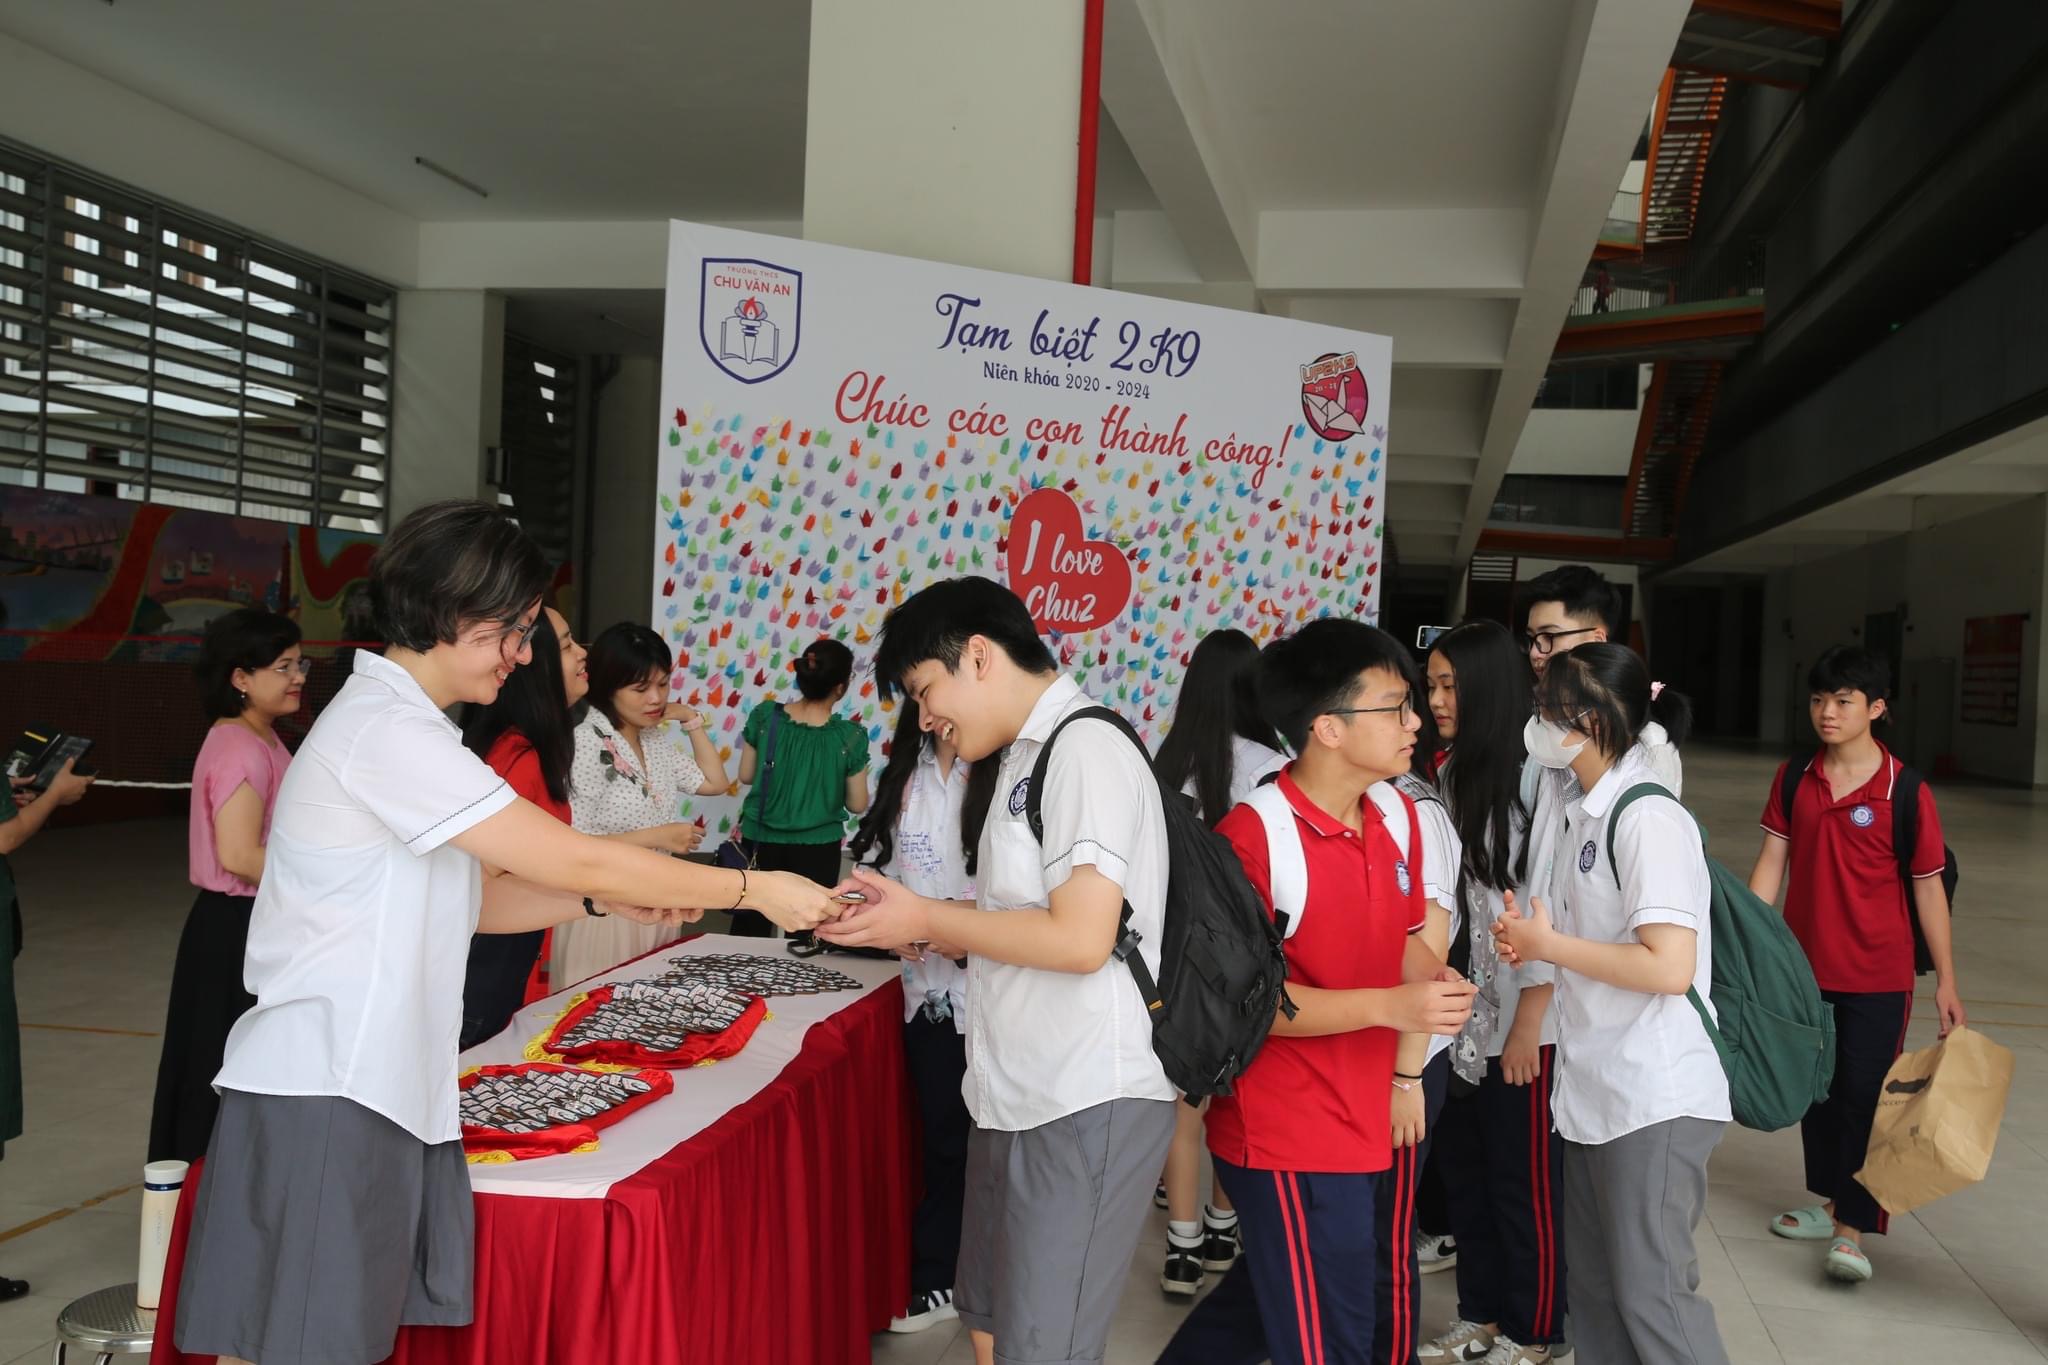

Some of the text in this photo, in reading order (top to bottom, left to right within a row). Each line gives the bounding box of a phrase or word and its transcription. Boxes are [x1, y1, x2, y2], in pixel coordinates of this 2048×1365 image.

[713, 275, 791, 297] CHU VĂN AN
[935, 293, 1013, 355] Tạm
[1029, 309, 1100, 368] biệt
[983, 361, 1018, 382] Niên
[1024, 366, 1060, 388] khóa
[1065, 373, 1100, 392] 2020
[1116, 380, 1151, 399] 2024
[835, 370, 1294, 490] Chúc các con thành công!
[1021, 519, 1104, 576] I love
[1025, 581, 1097, 623] Chu2
